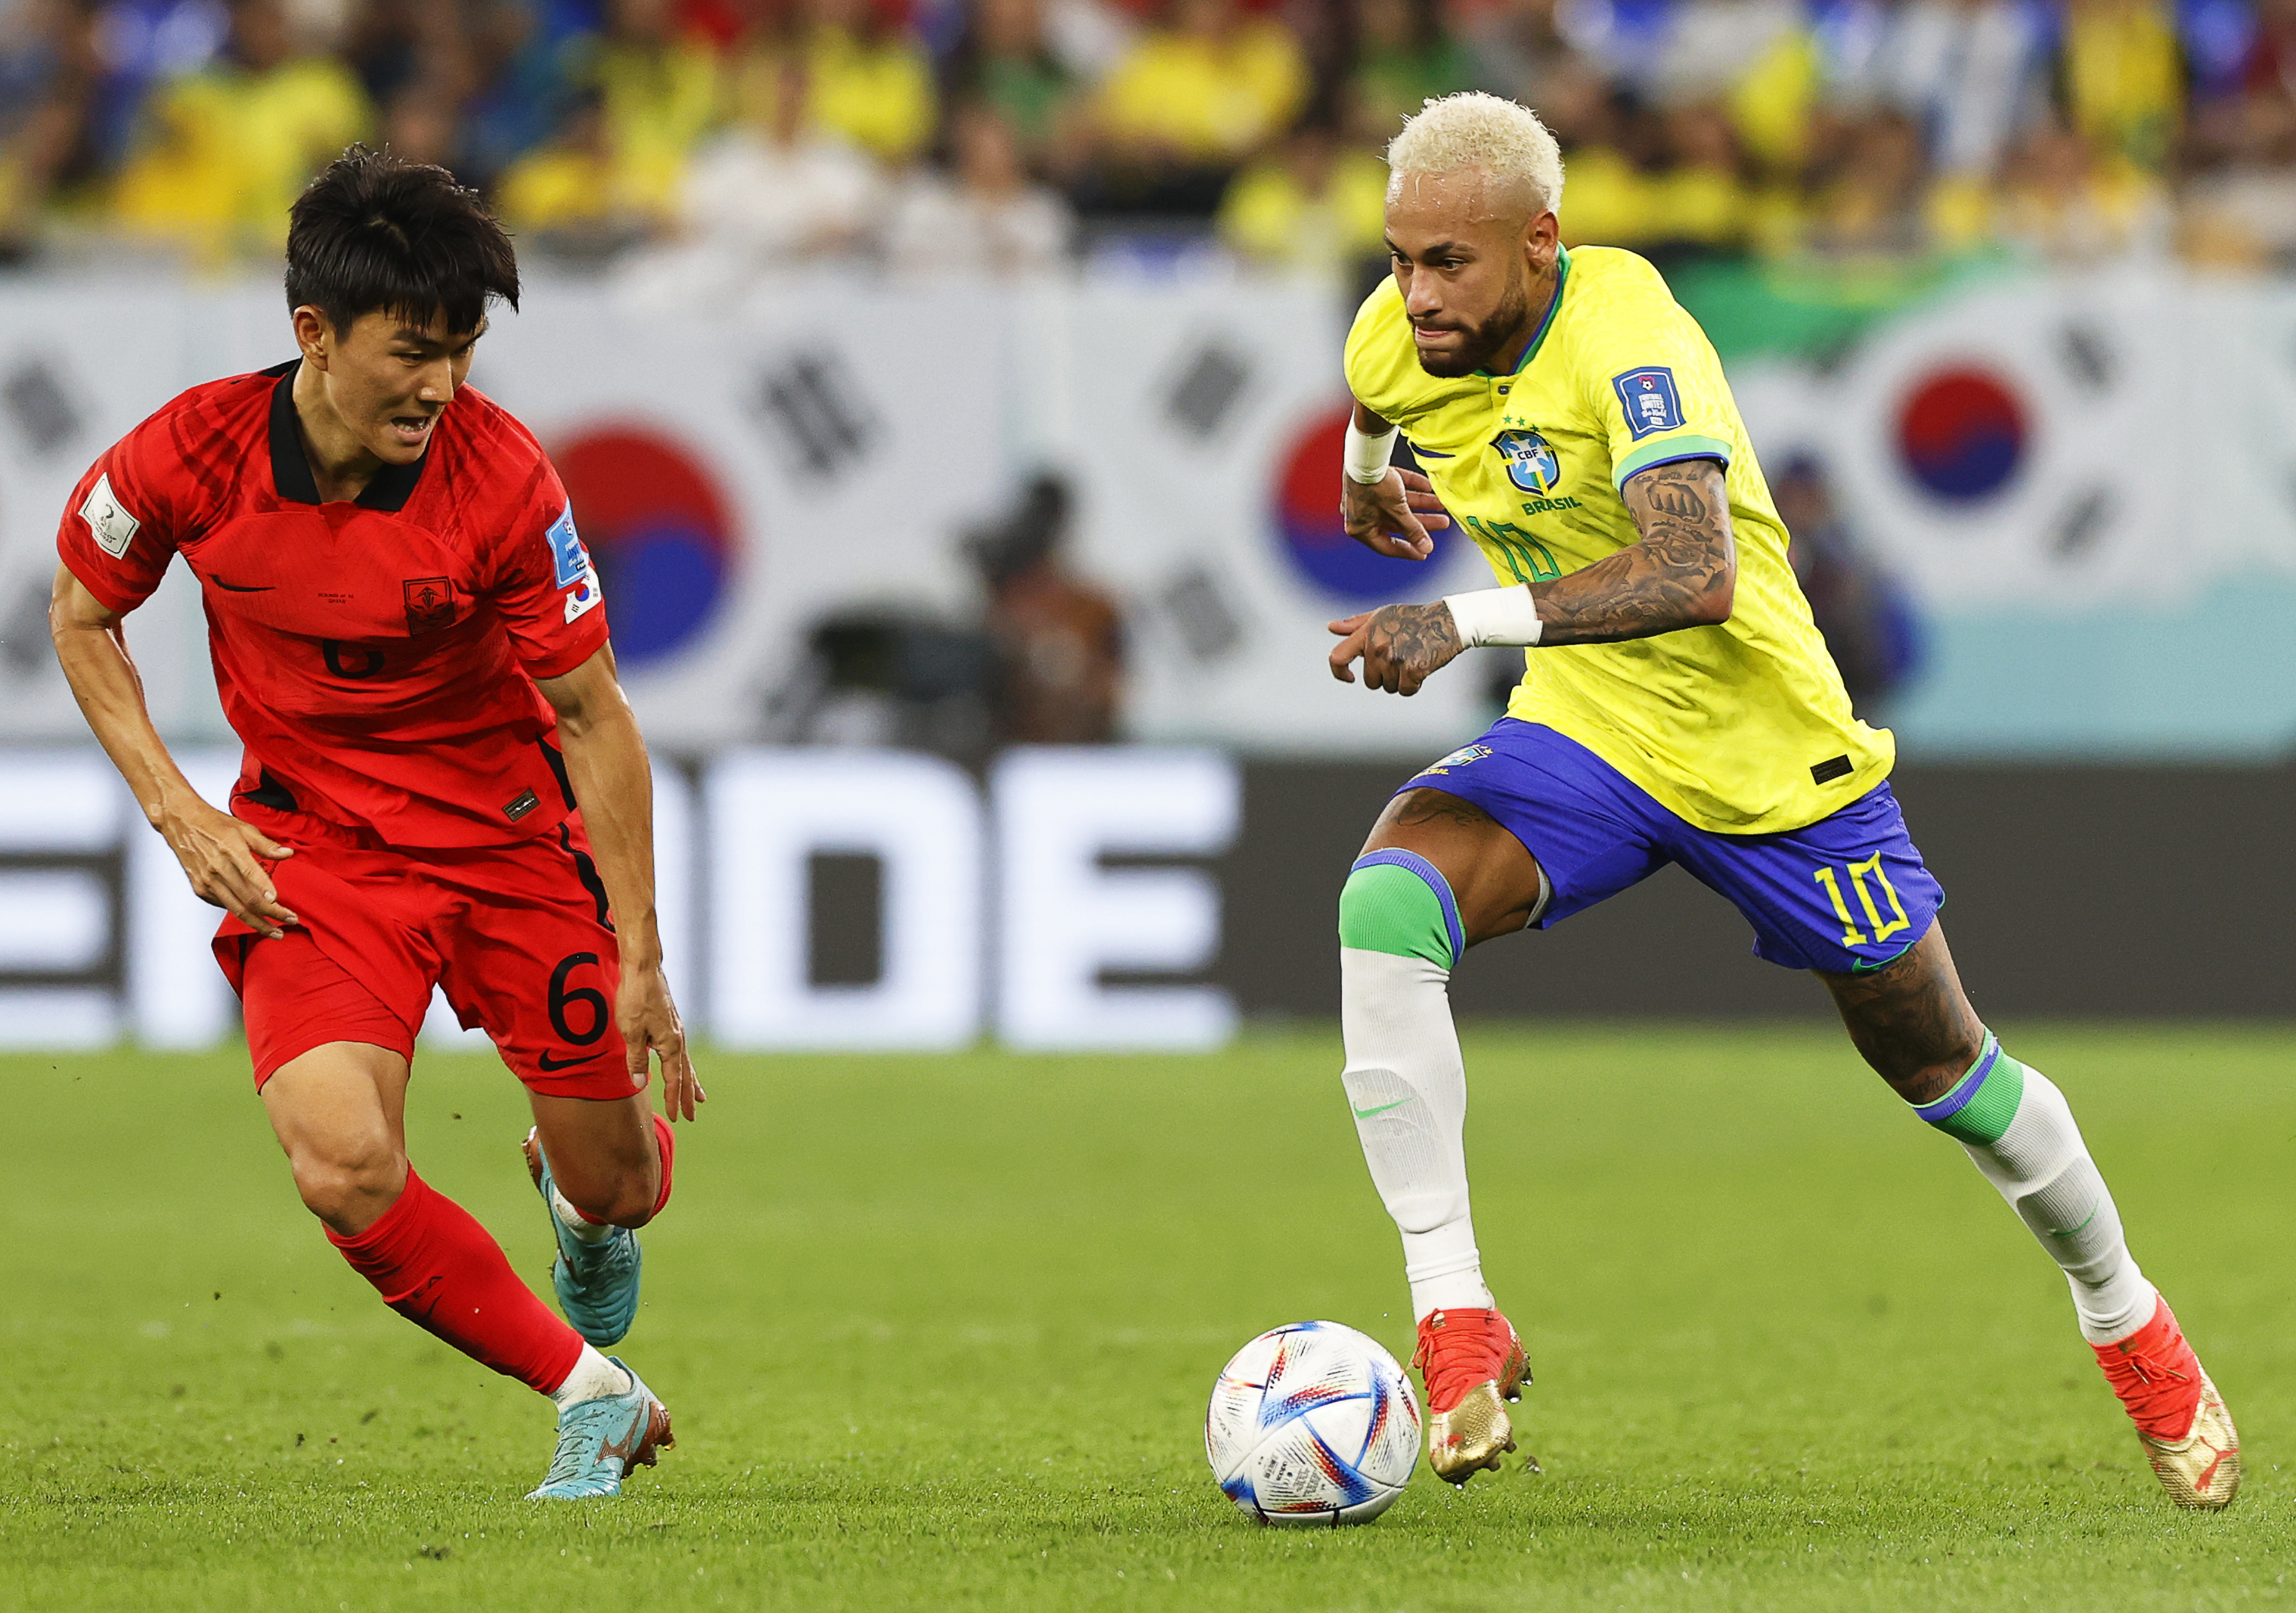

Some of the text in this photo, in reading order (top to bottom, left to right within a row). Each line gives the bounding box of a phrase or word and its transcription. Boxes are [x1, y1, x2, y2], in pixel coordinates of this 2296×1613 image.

[1640, 399, 1665, 411] UNITES
[1517, 448, 1539, 461] CBF
[1521, 496, 1583, 516] BRASIL
[1813, 849, 1912, 949] 10
[547, 951, 609, 1046] 6
